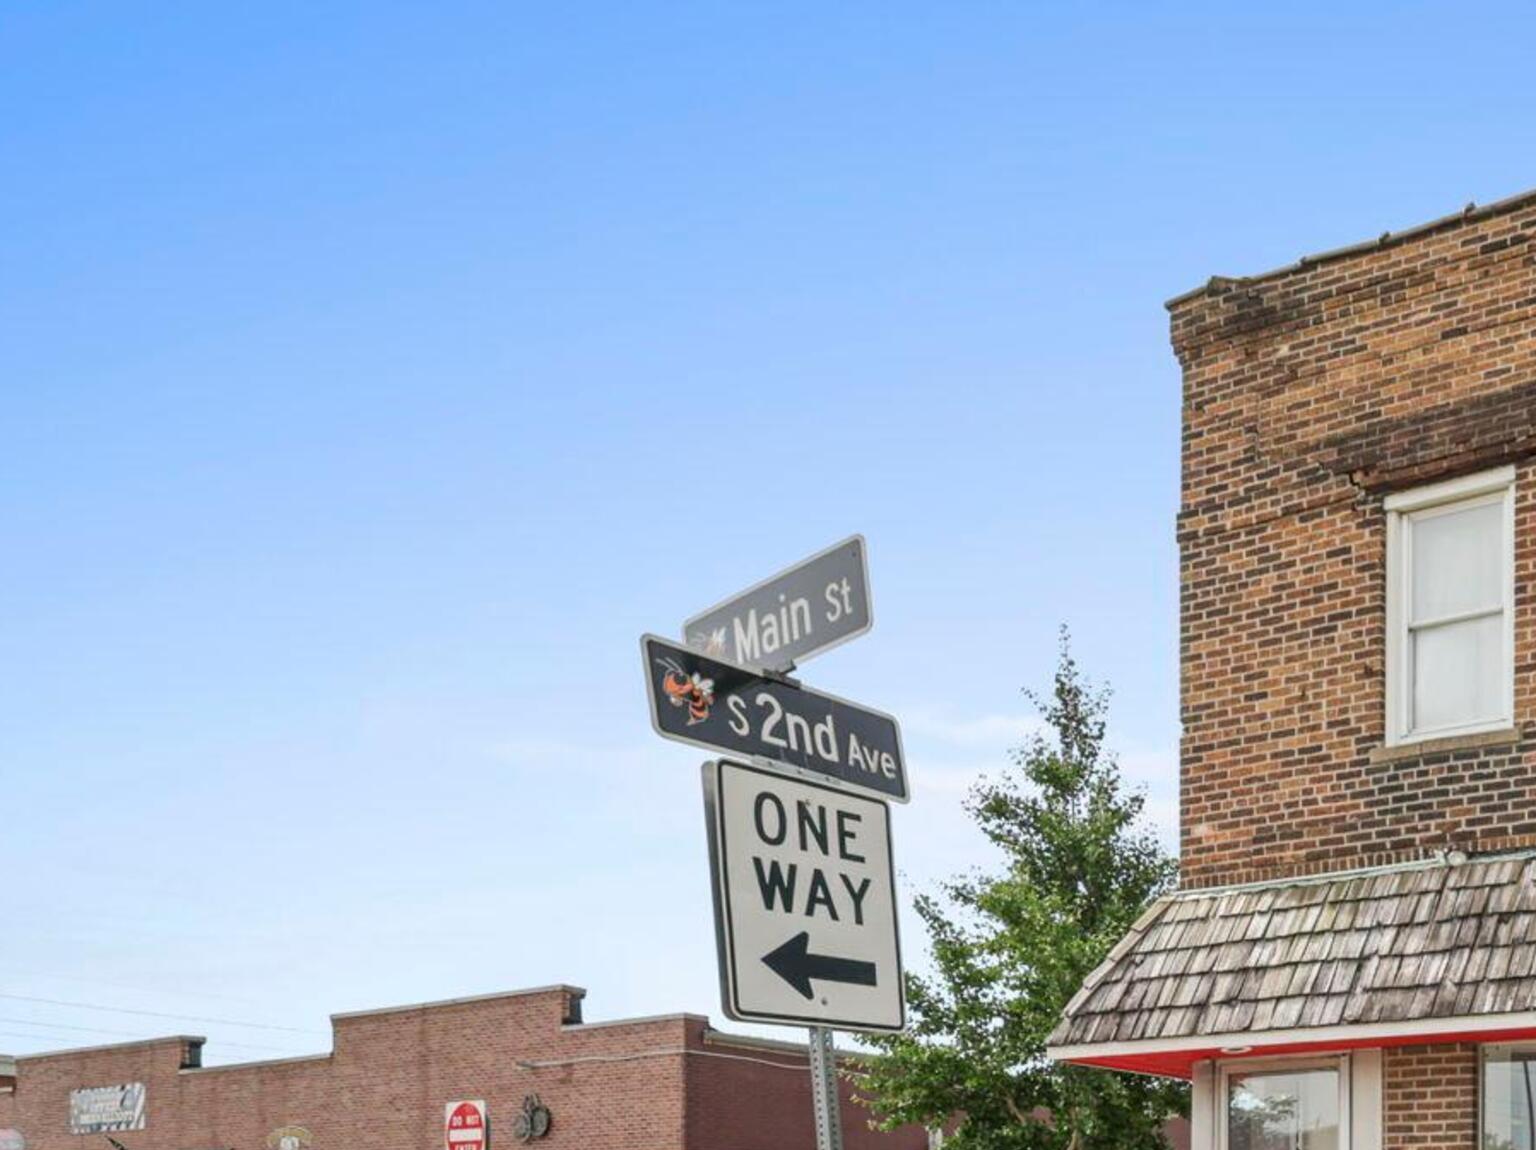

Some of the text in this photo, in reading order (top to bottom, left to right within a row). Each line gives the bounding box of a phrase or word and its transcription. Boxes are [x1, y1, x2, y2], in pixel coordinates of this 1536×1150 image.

[733, 576, 853, 665] Main St
[726, 692, 897, 779] S 2nd Ave
[753, 791, 866, 864] ONE
[752, 855, 871, 926] WAY
[452, 1114, 480, 1127] DO NOT
